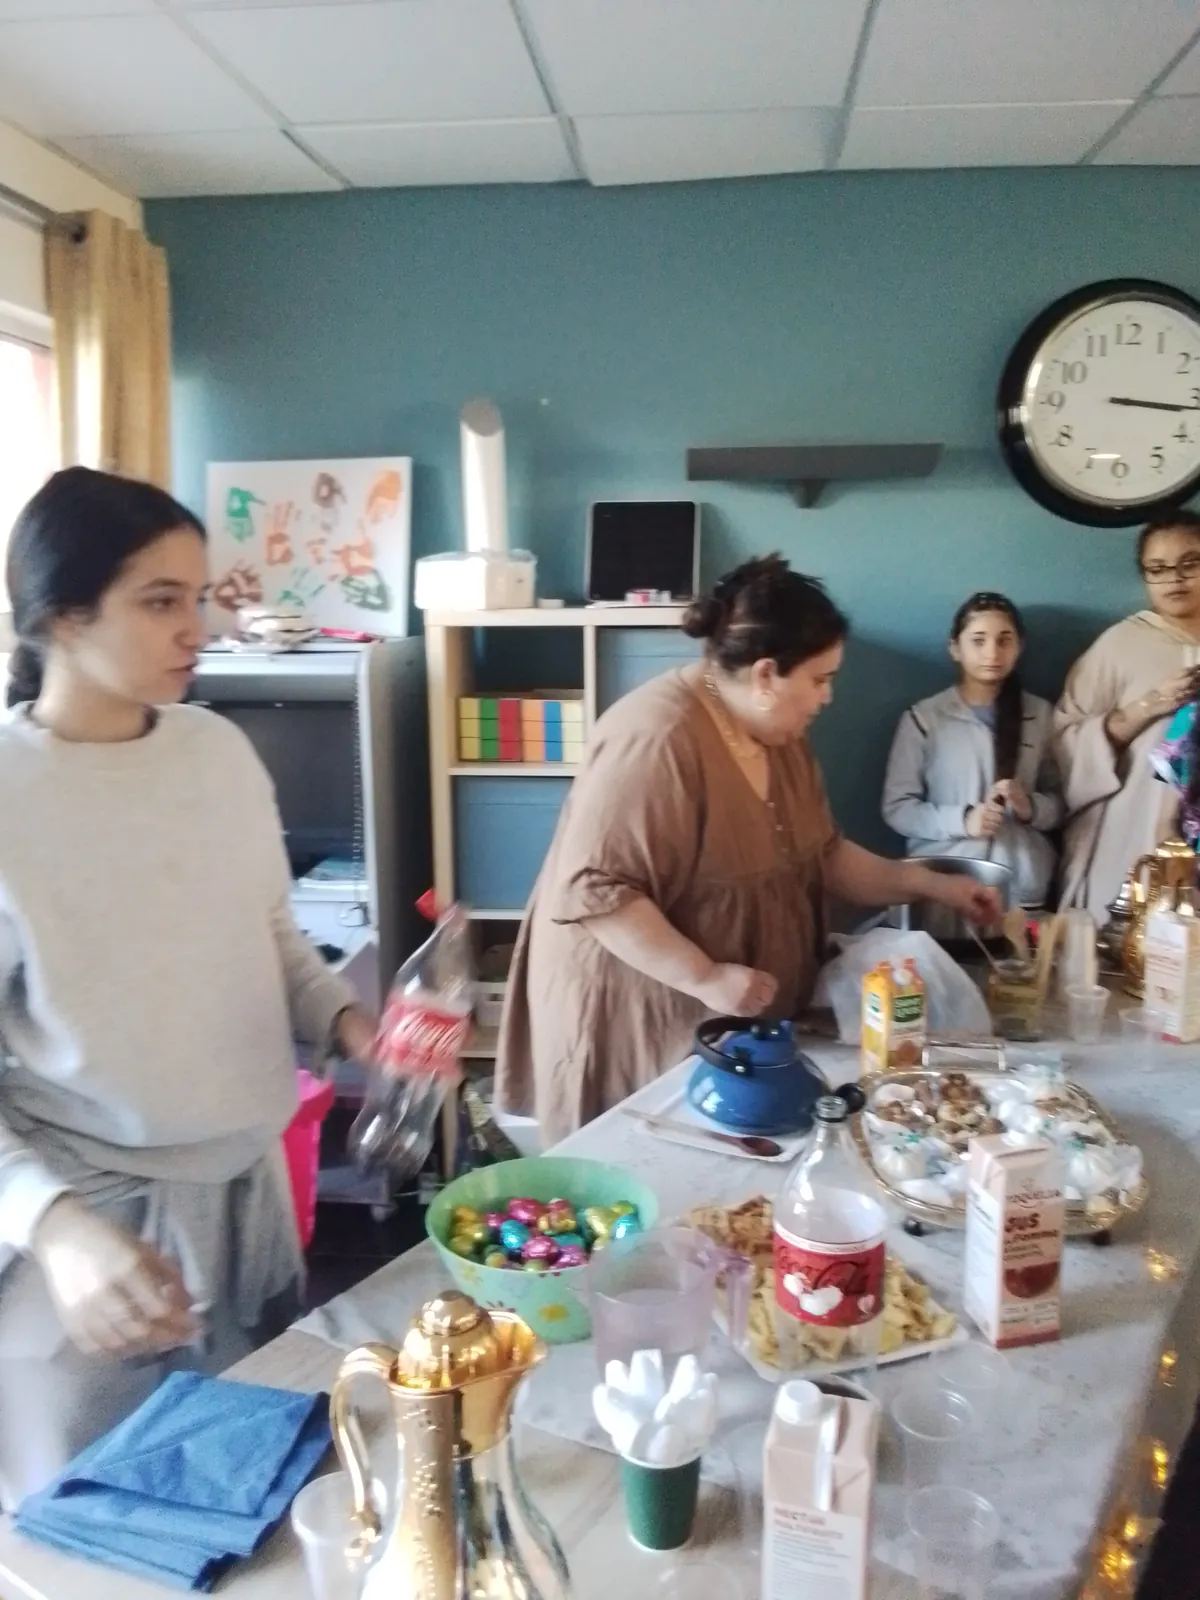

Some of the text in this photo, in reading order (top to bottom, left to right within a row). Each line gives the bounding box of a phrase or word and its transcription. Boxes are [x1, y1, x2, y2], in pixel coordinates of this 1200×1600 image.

[1115, 322, 1143, 345] 12
[1086, 334, 1108, 357] 11
[1061, 361, 1089, 384] 10
[1175, 352, 1191, 374] 2
